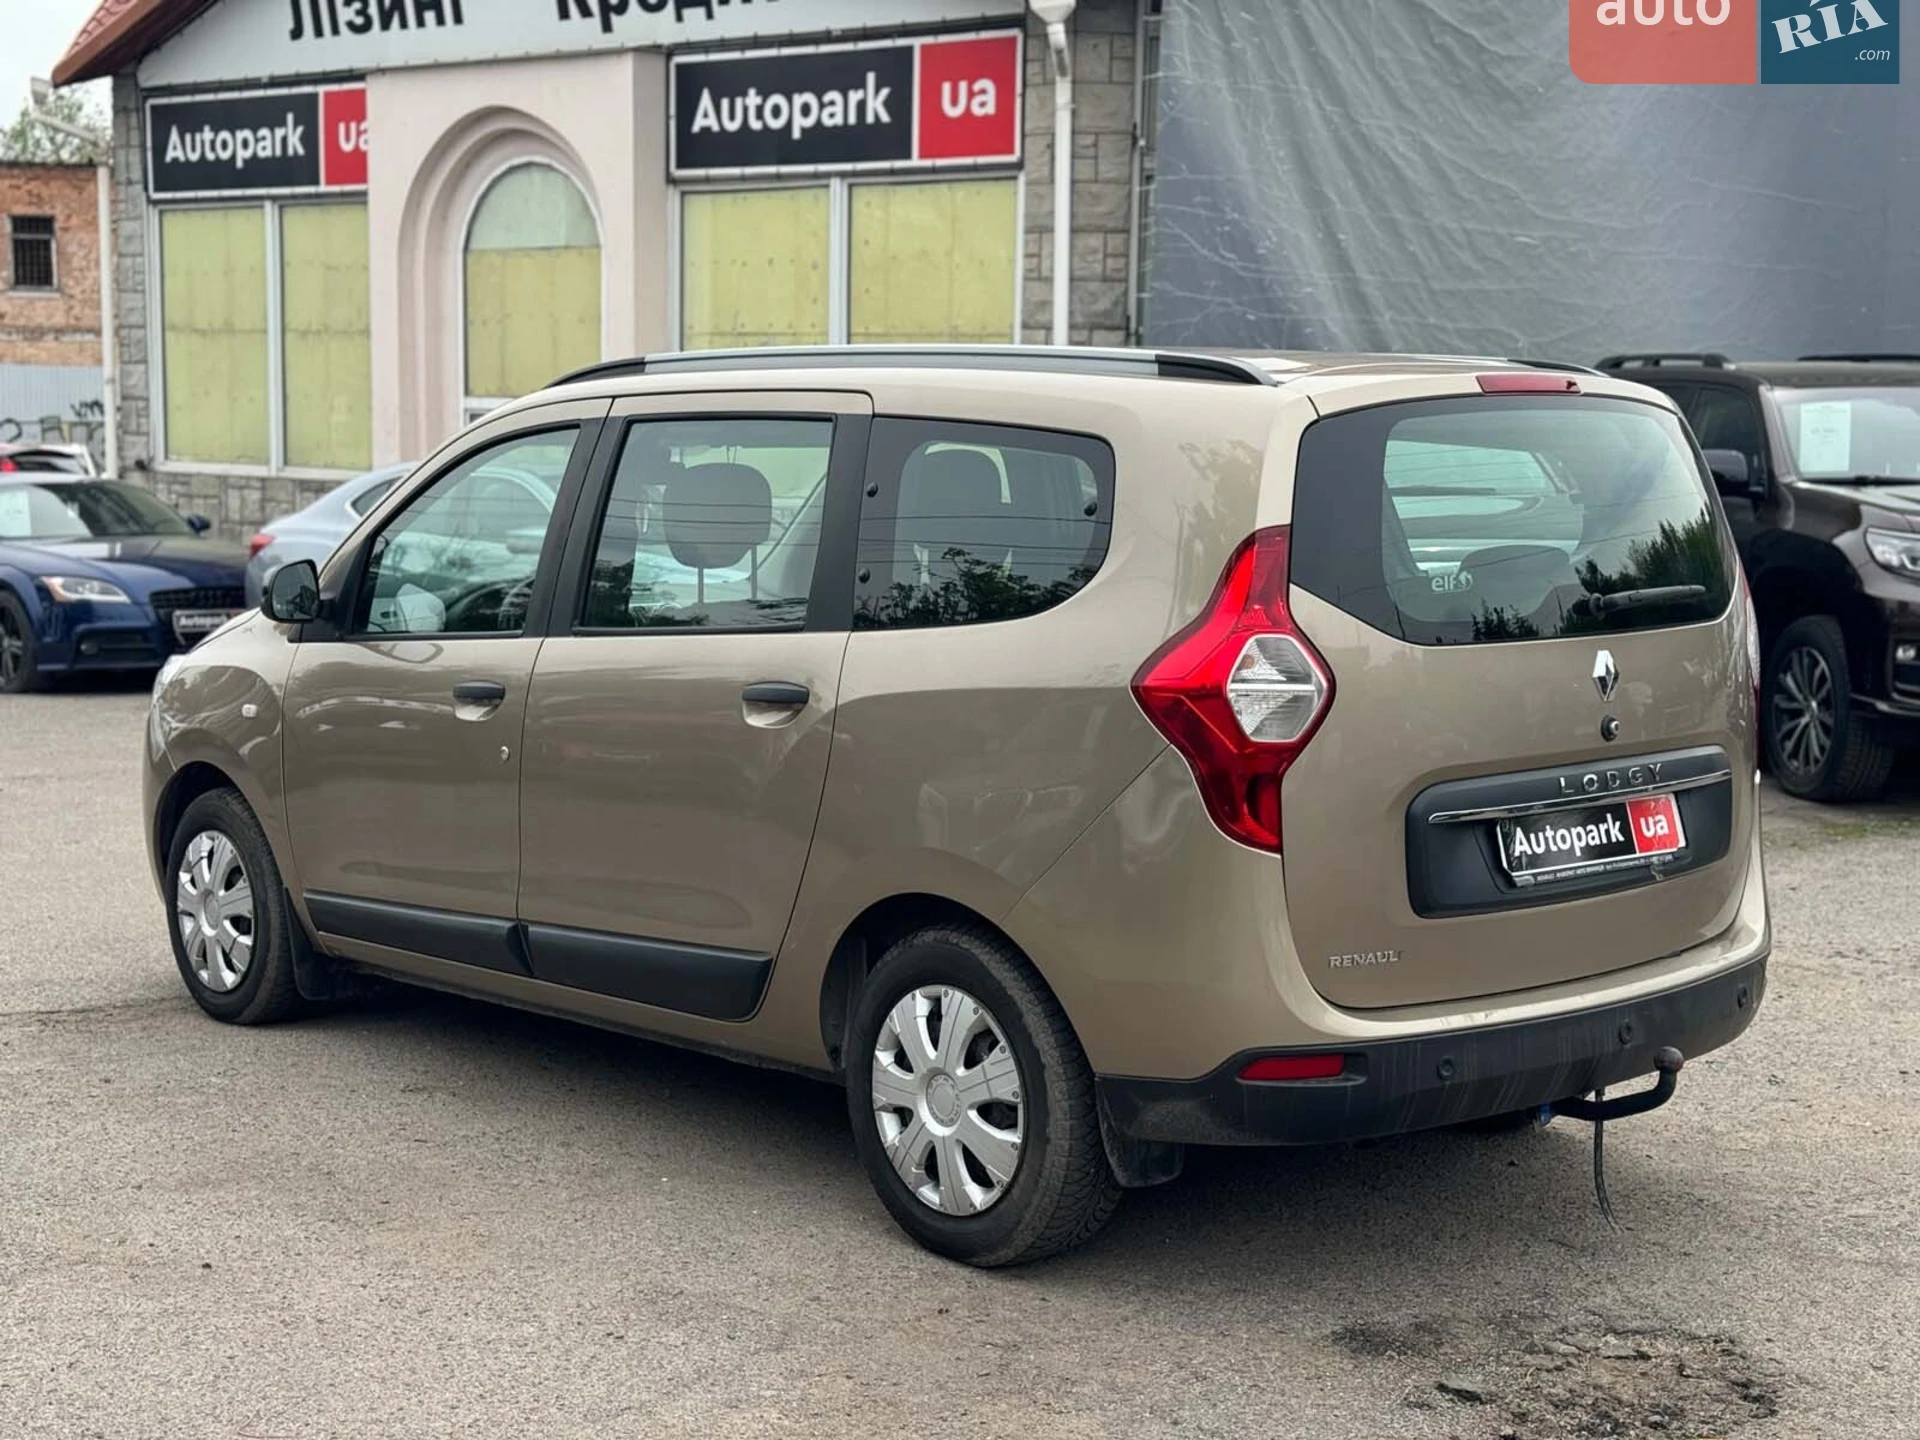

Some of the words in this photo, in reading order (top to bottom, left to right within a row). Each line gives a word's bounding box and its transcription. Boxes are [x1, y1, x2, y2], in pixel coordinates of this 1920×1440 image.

[691, 71, 892, 140] Autopark
[941, 78, 996, 118] ua
[164, 112, 305, 169] Autopark
[1431, 574, 1457, 592] elf
[1559, 763, 1662, 793] LODGY
[1513, 813, 1625, 857] Autopark
[1640, 814, 1669, 838] ua
